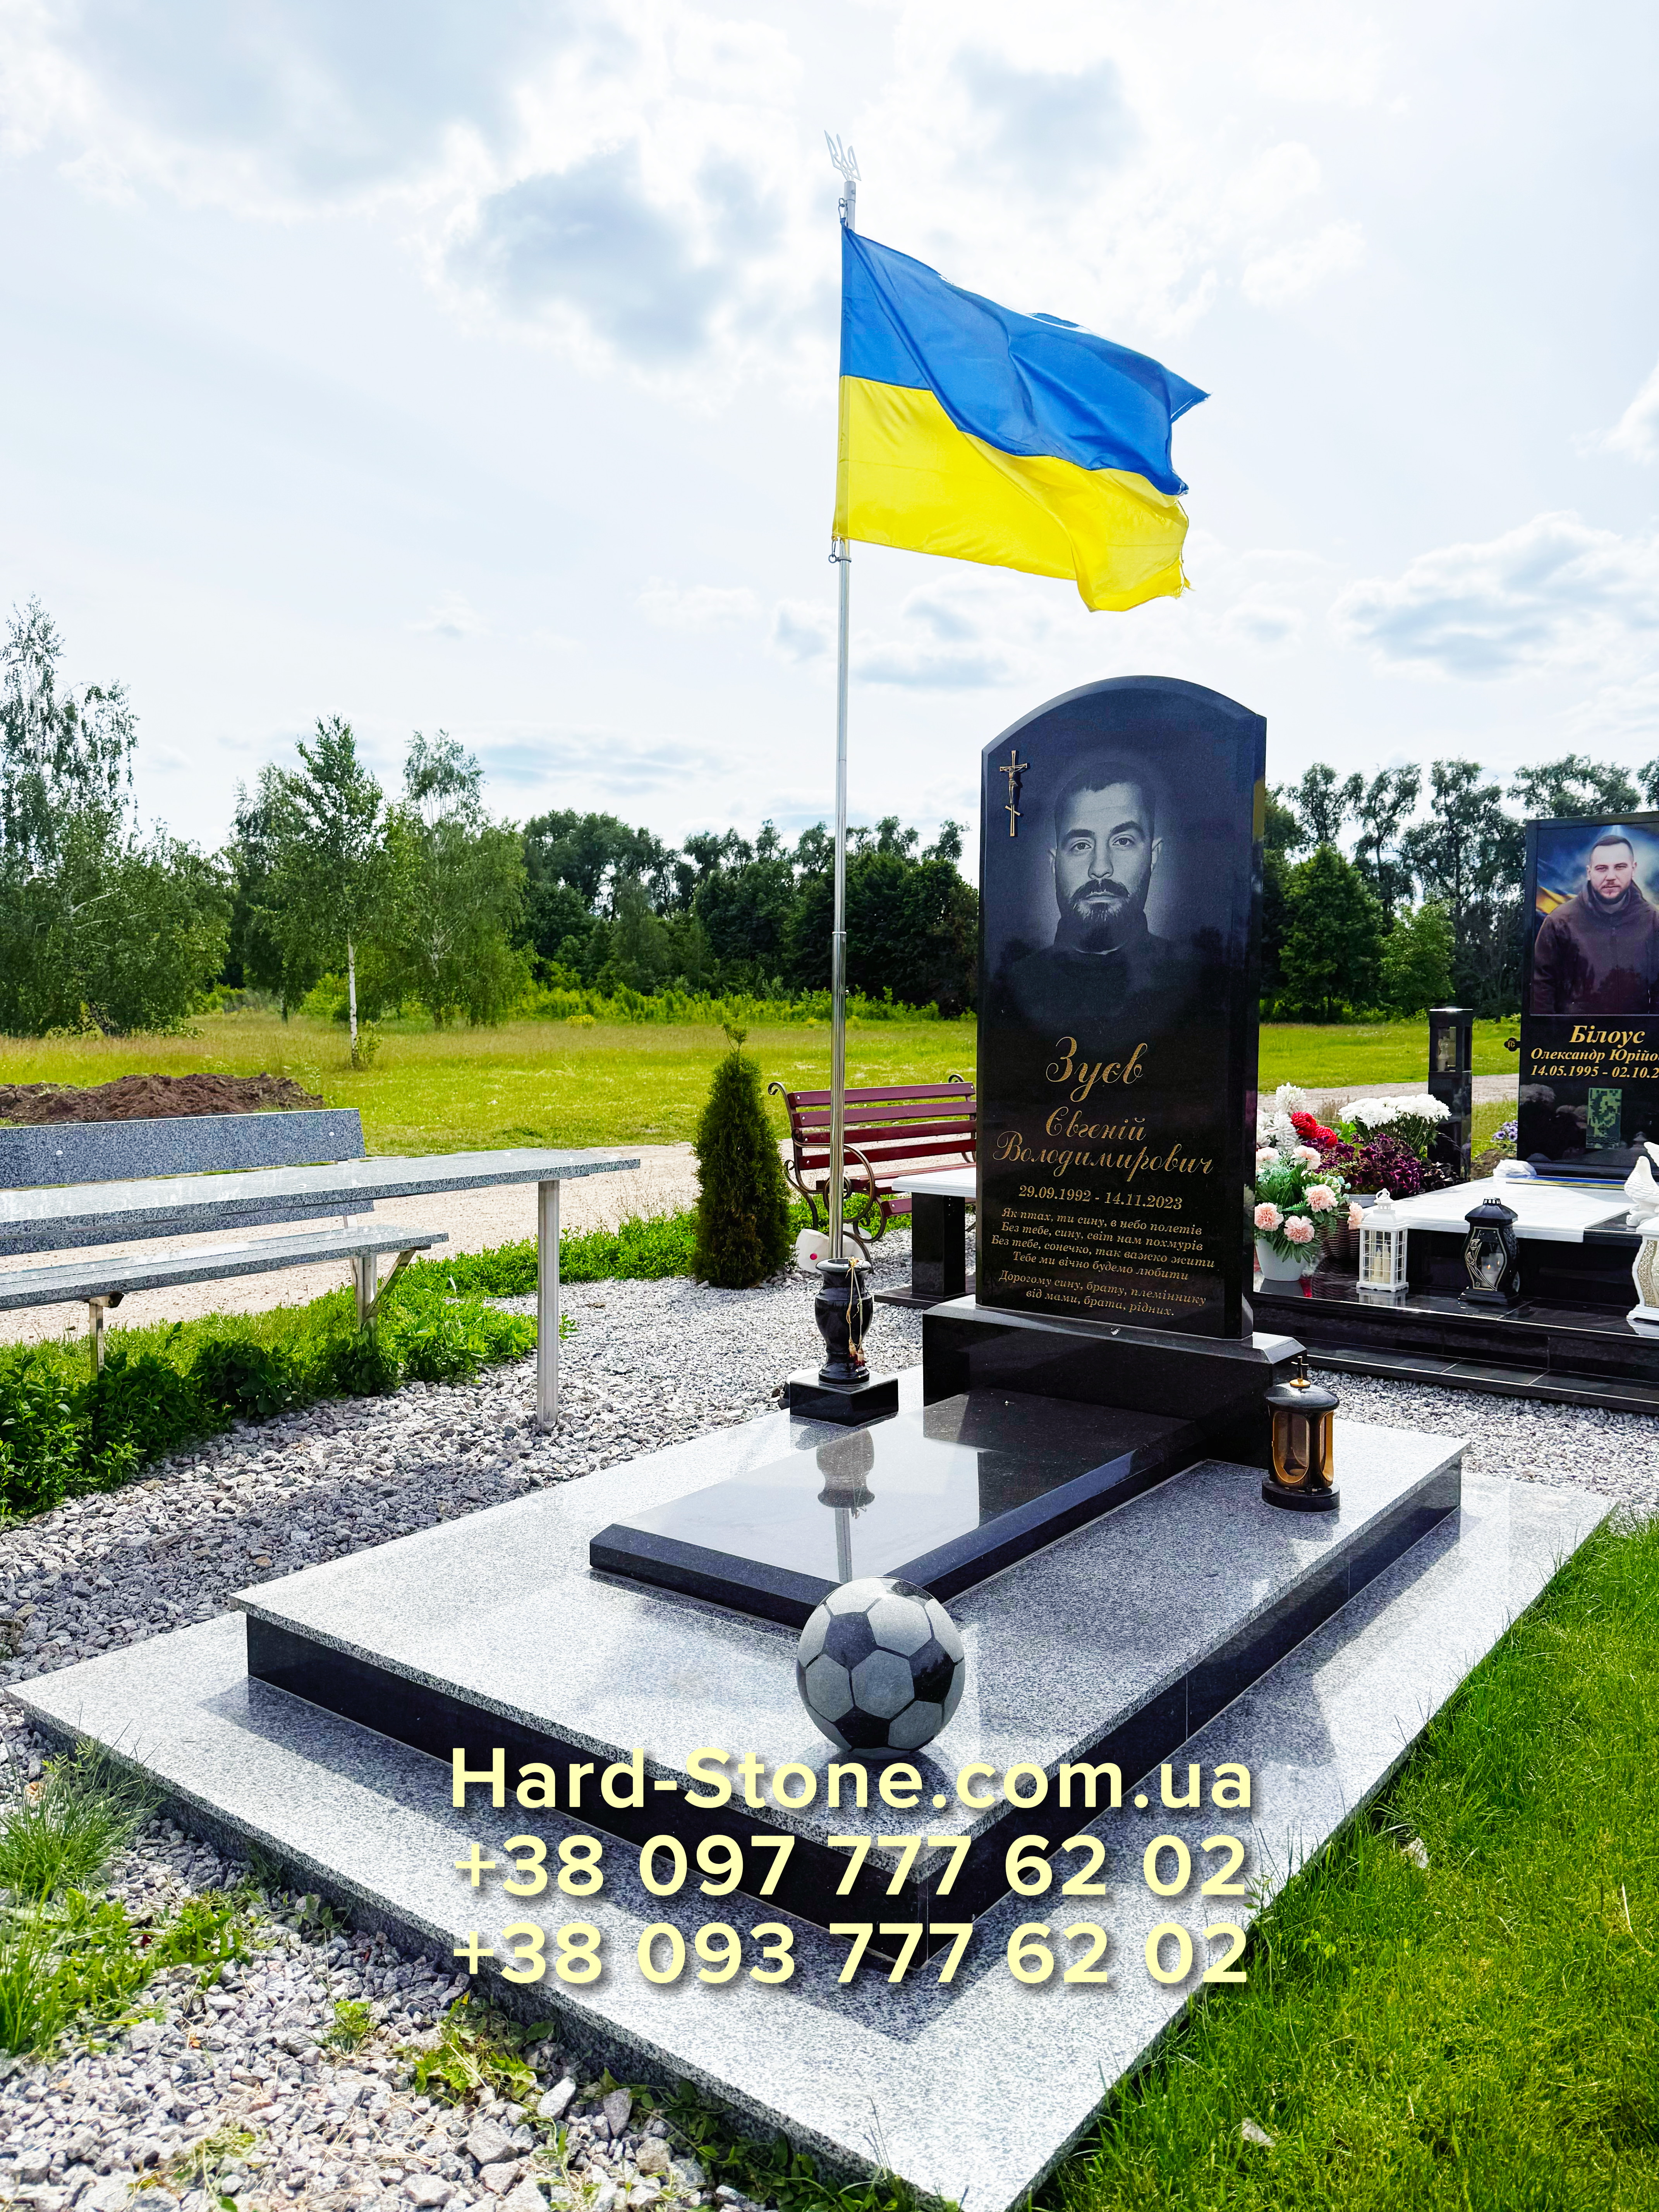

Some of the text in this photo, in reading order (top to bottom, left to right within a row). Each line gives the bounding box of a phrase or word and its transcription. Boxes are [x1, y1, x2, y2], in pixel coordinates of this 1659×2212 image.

[1569, 1025, 1645, 1048] Білоус
[1046, 1036, 1148, 1102] Зуєв
[1531, 1048, 1659, 1064] Олександр Юрійо
[1530, 1065, 1599, 1077] 14.05.1995
[1046, 1106, 1147, 1141] Євгеній
[993, 1131, 1214, 1182] Володимирович
[1018, 1185, 1091, 1202] 29.09.1992
[1104, 1192, 1182, 1209] 14.11.2023
[1001, 1207, 1017, 1218] Як
[1020, 1211, 1054, 1222] птах,
[1057, 1214, 1075, 1223] ти
[1077, 1217, 1107, 1228] сину,
[1120, 1219, 1147, 1230] небо
[1150, 1224, 1202, 1235] полетів
[1001, 1221, 1203, 1252] Без тебе, сину, світ нам похмурів
[991, 1235, 1215, 1268] Без тебе, сонечко, так важко жити
[1013, 1251, 1189, 1280] Тебе ми вічно будемо любити
[998, 1270, 1207, 1307] Дорогому сину, брату, племіннику
[1026, 1288, 1175, 1316] від мами, брата, рідних.
